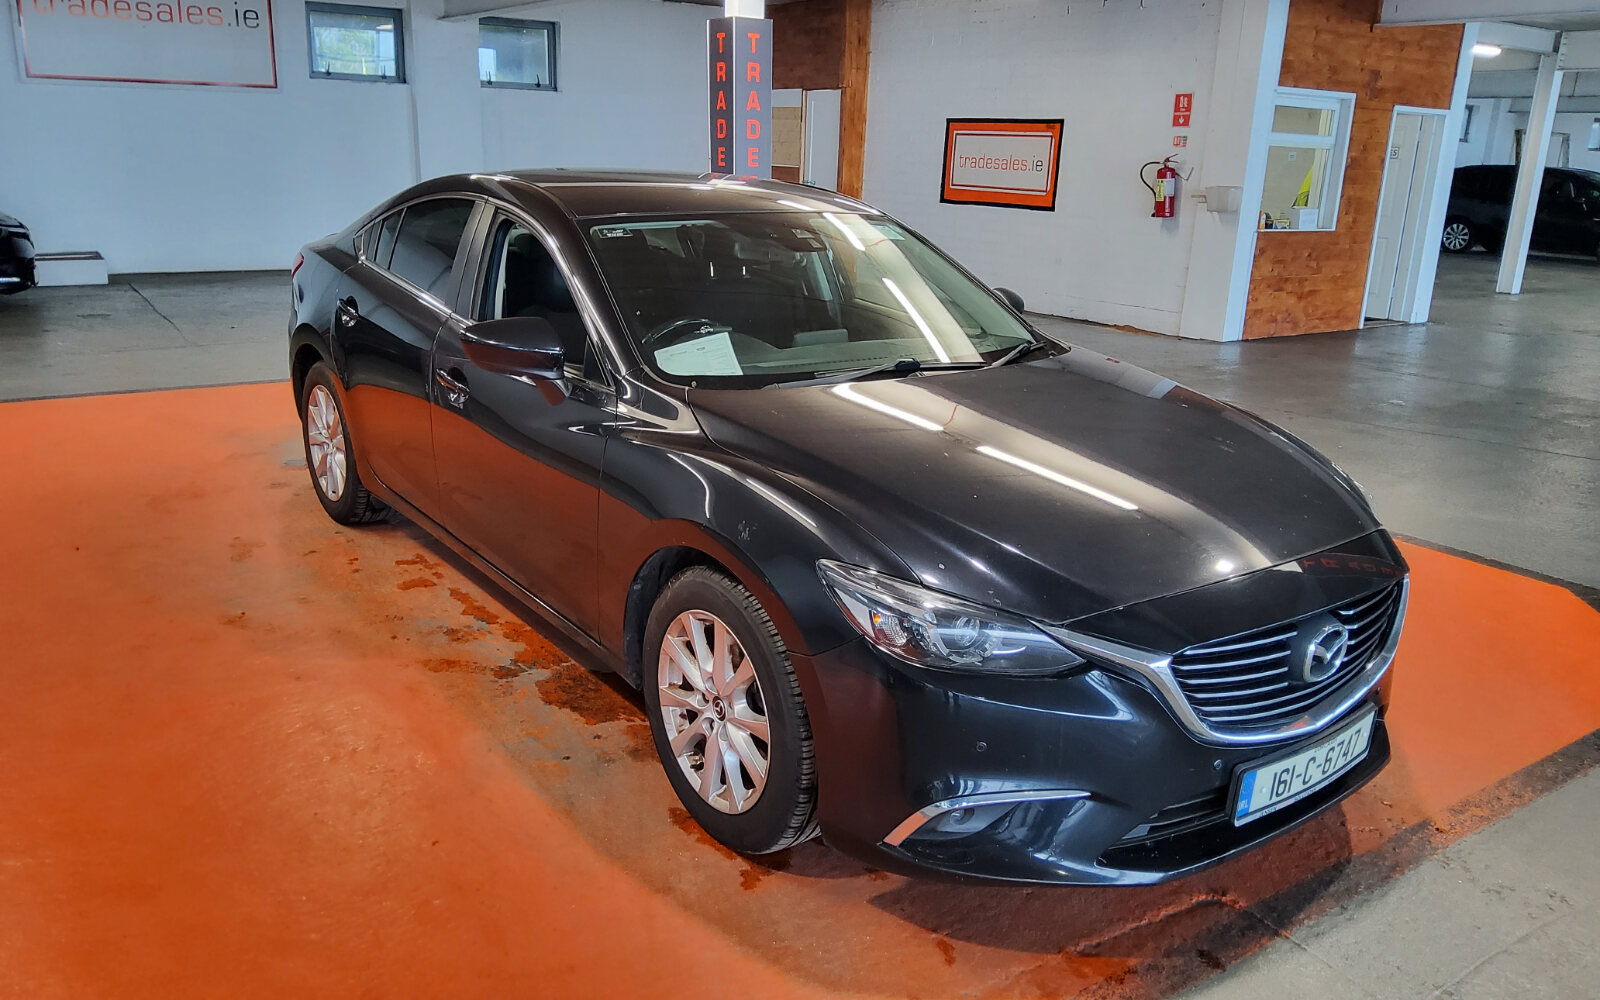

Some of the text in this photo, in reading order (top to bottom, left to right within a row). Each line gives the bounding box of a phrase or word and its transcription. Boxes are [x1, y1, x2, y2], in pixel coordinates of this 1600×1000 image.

[33, 0, 260, 28] tradesales.ie
[716, 32, 727, 167] TRADE
[746, 32, 761, 167] TRADE
[959, 153, 1043, 172] tradesales.ie
[1269, 728, 1361, 801] 161-C-6747
